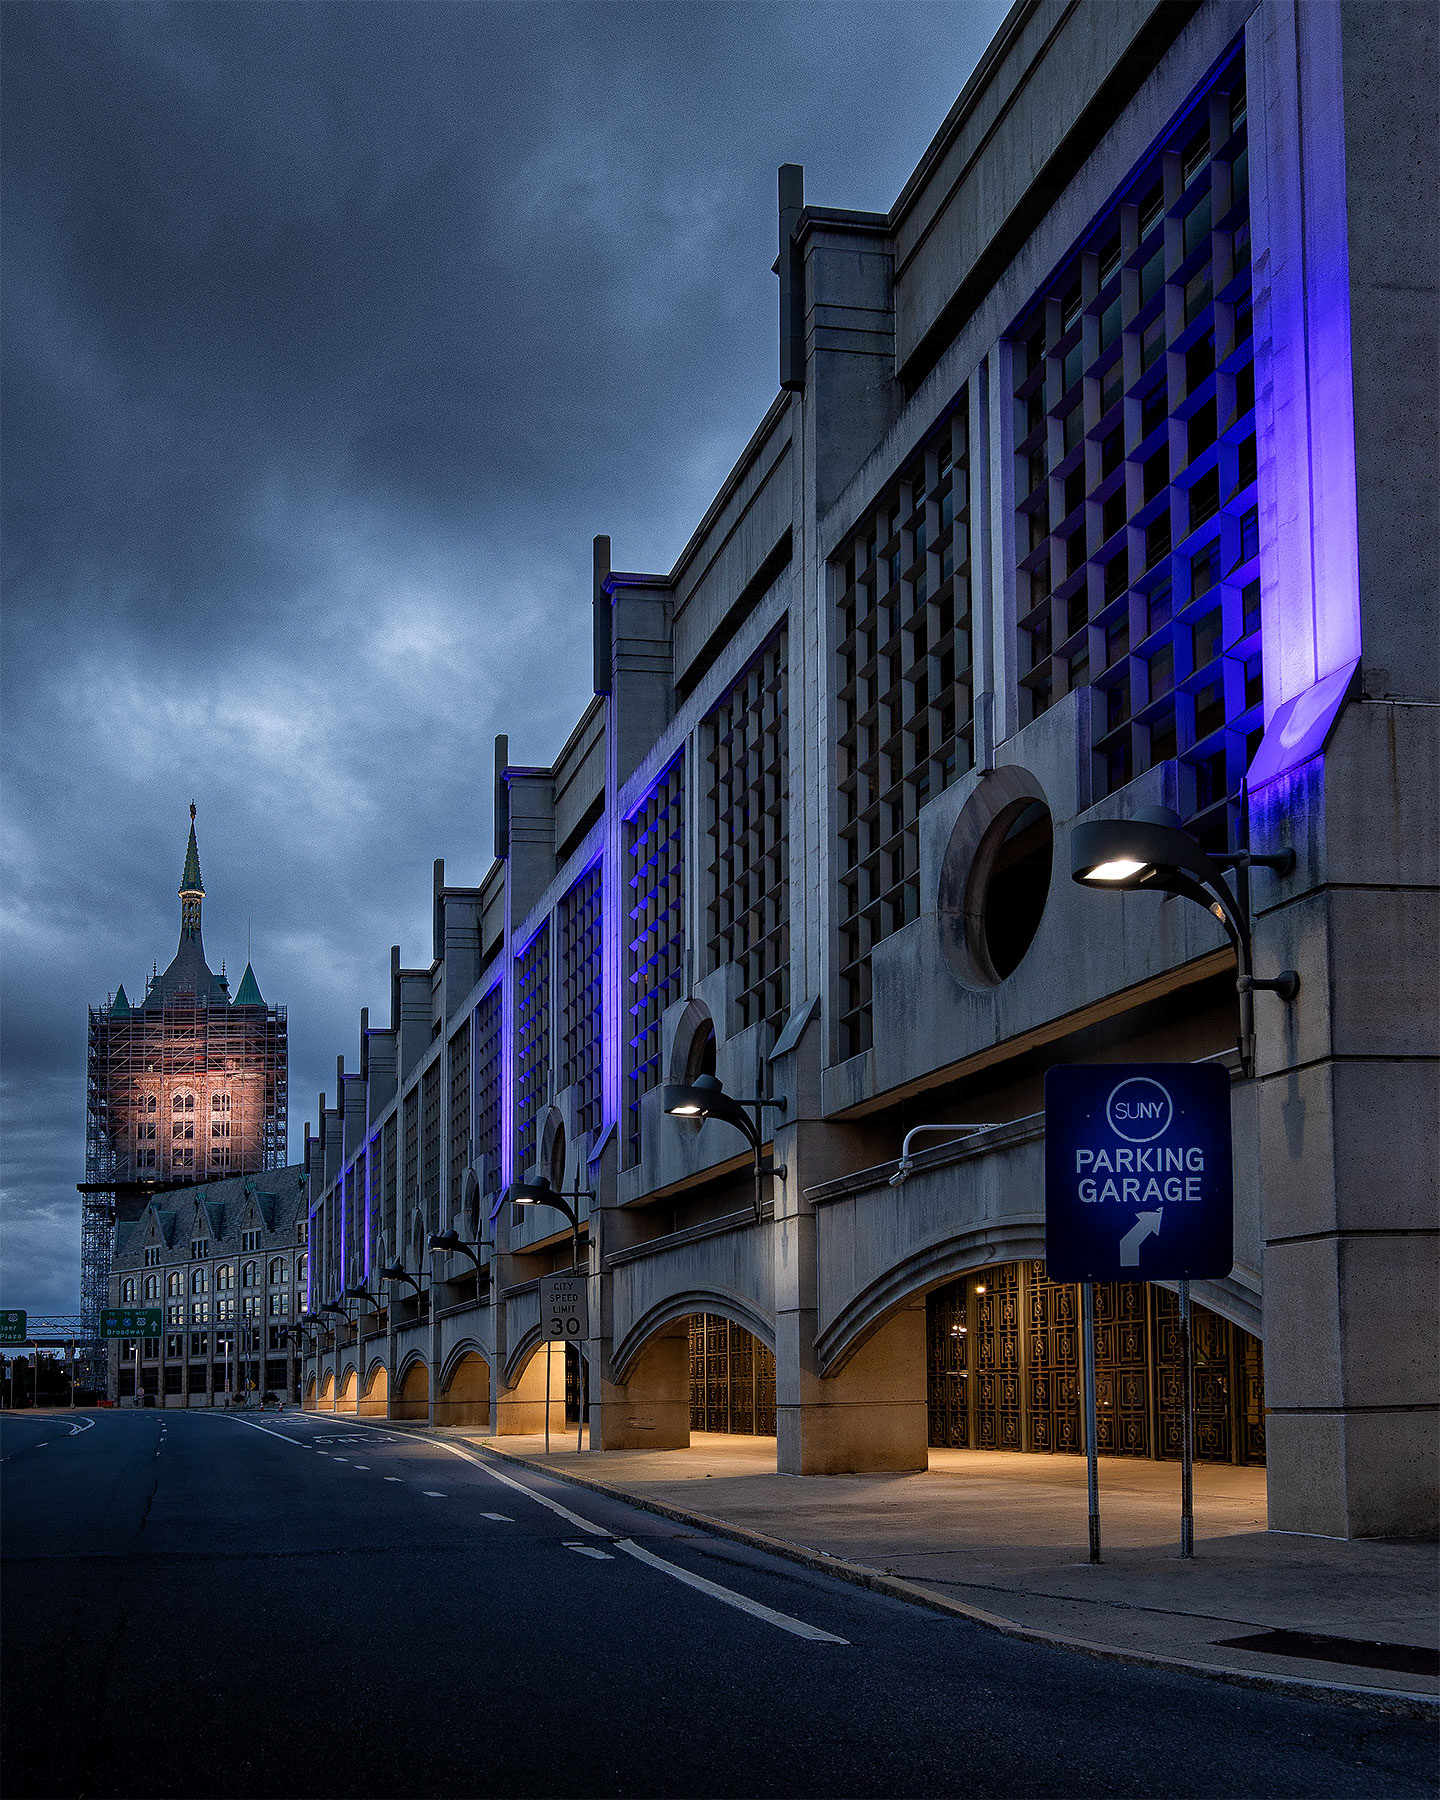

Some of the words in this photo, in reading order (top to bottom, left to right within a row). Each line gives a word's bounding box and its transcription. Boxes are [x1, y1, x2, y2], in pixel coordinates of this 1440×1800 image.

[1115, 1102, 1164, 1119] SUNY
[1076, 1147, 1204, 1173] PARKING
[1078, 1177, 1202, 1202] GARAGE
[554, 1282, 573, 1290] CITY
[549, 1293, 578, 1302] SPEED
[553, 1305, 576, 1313] LIMIT
[550, 1317, 580, 1335] 30
